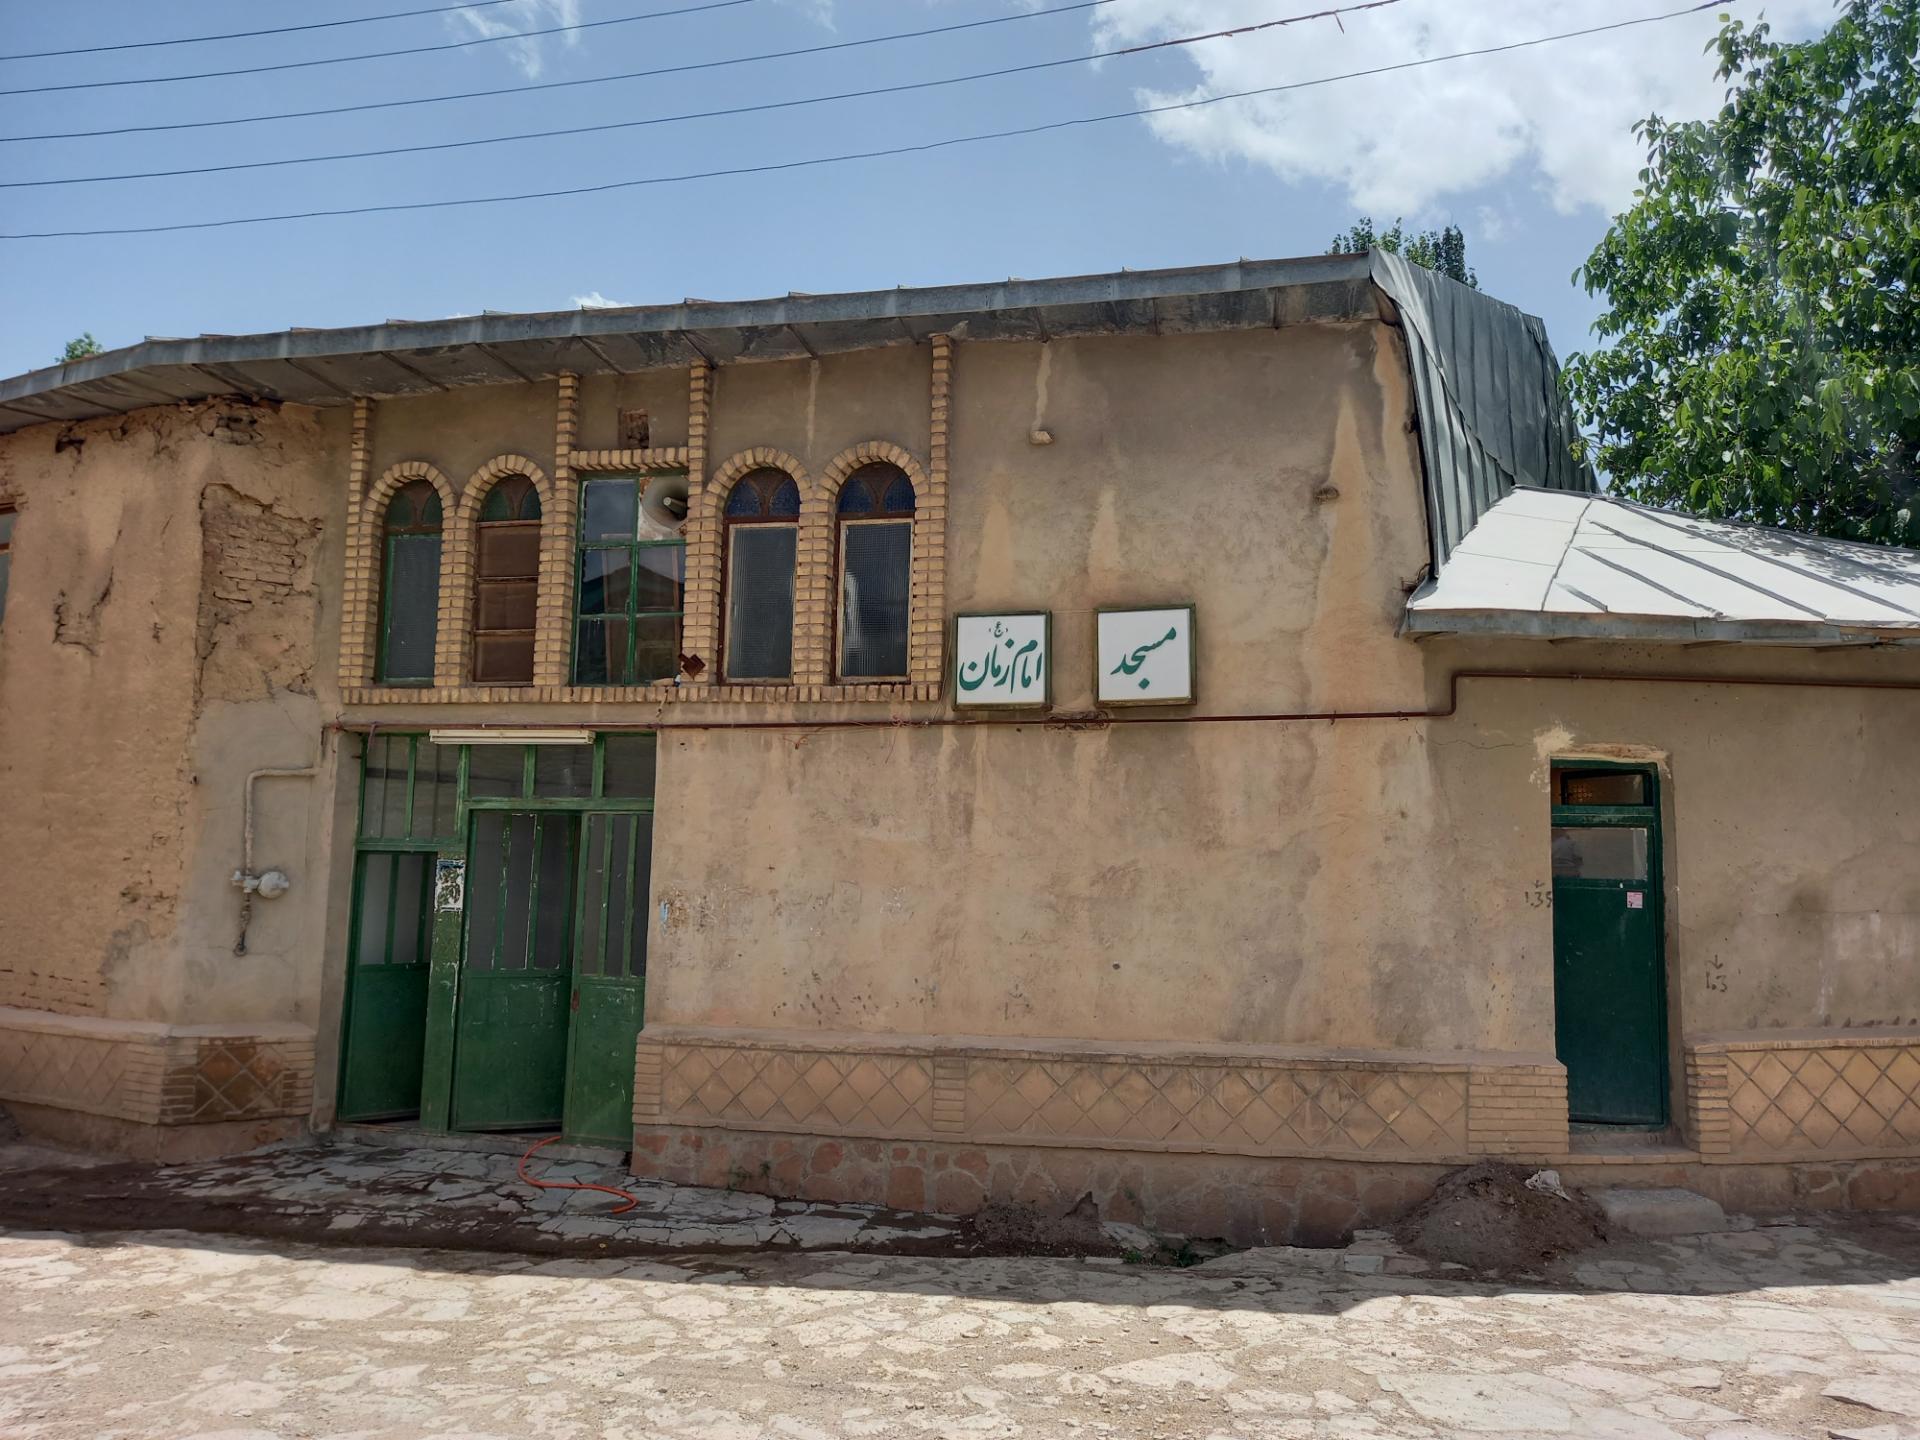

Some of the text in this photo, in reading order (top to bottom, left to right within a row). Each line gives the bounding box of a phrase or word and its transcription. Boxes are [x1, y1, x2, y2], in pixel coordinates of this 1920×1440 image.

[959, 638, 1043, 693] امام زمان
[1110, 626, 1177, 690] مسجد
